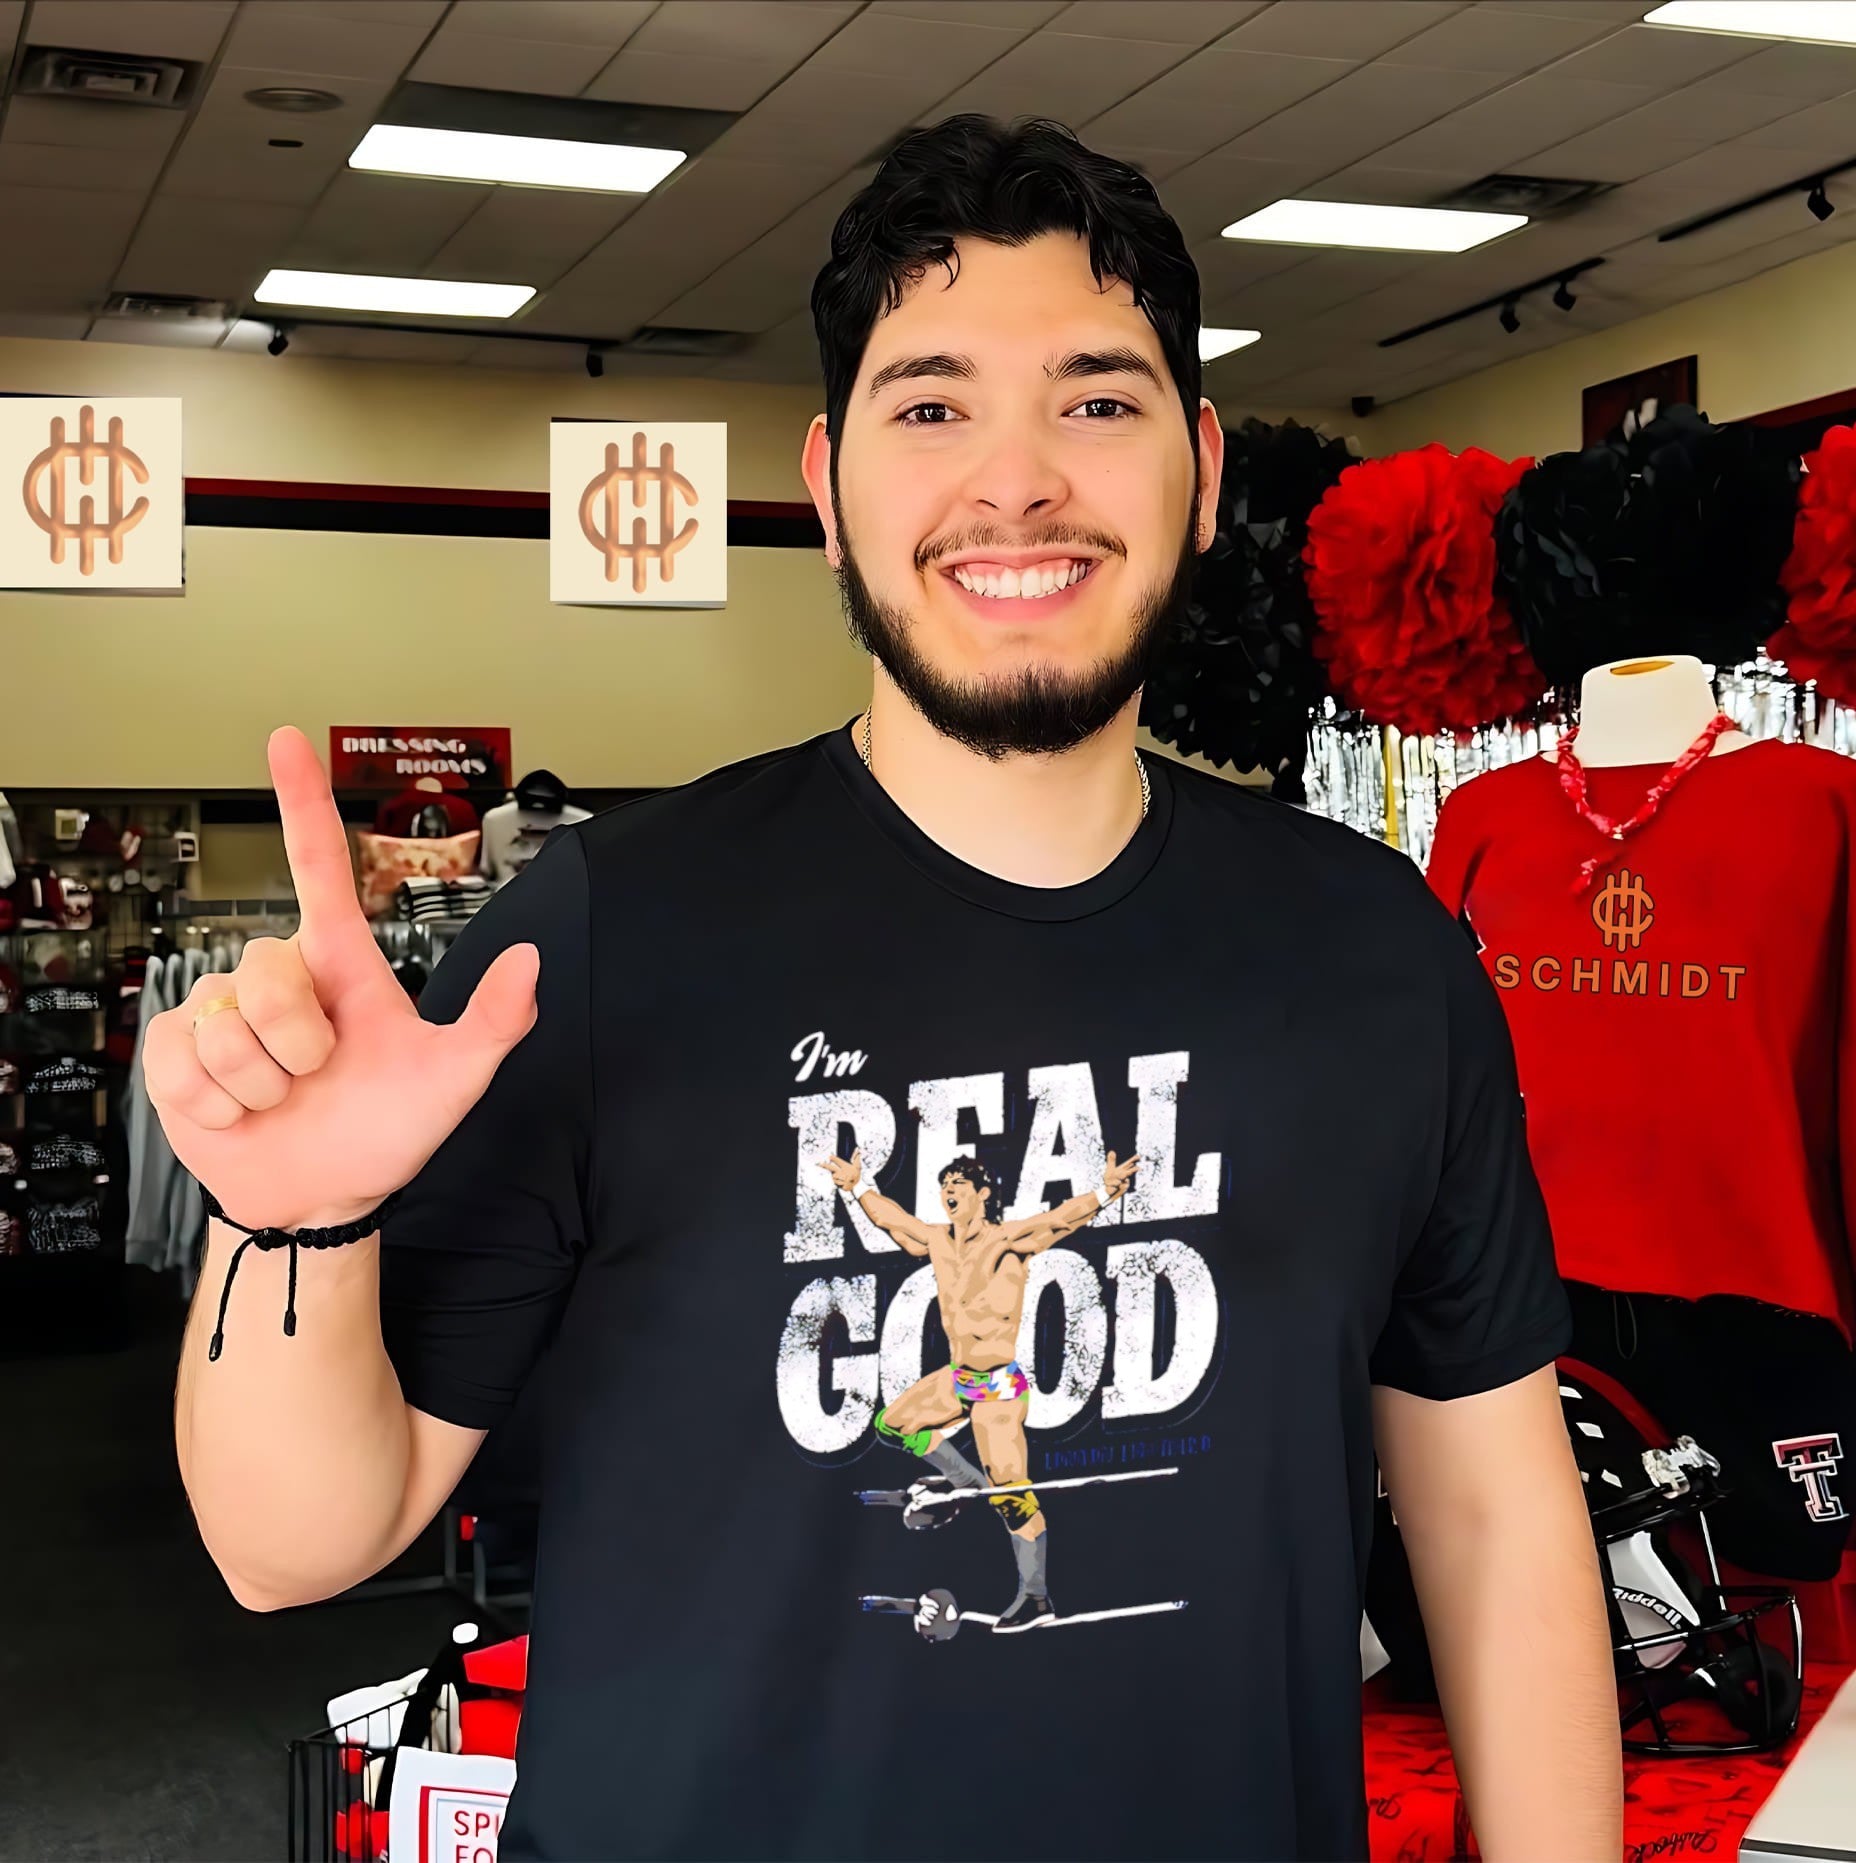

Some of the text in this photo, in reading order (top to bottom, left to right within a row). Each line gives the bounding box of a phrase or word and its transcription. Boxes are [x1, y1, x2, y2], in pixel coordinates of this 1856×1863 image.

[395, 758, 488, 776] ROOMS
[1494, 953, 1747, 1000] SCHMIDT
[790, 1031, 868, 1082] I'm
[783, 1051, 1223, 1264] REAL
[776, 1238, 1219, 1454] GOOD
